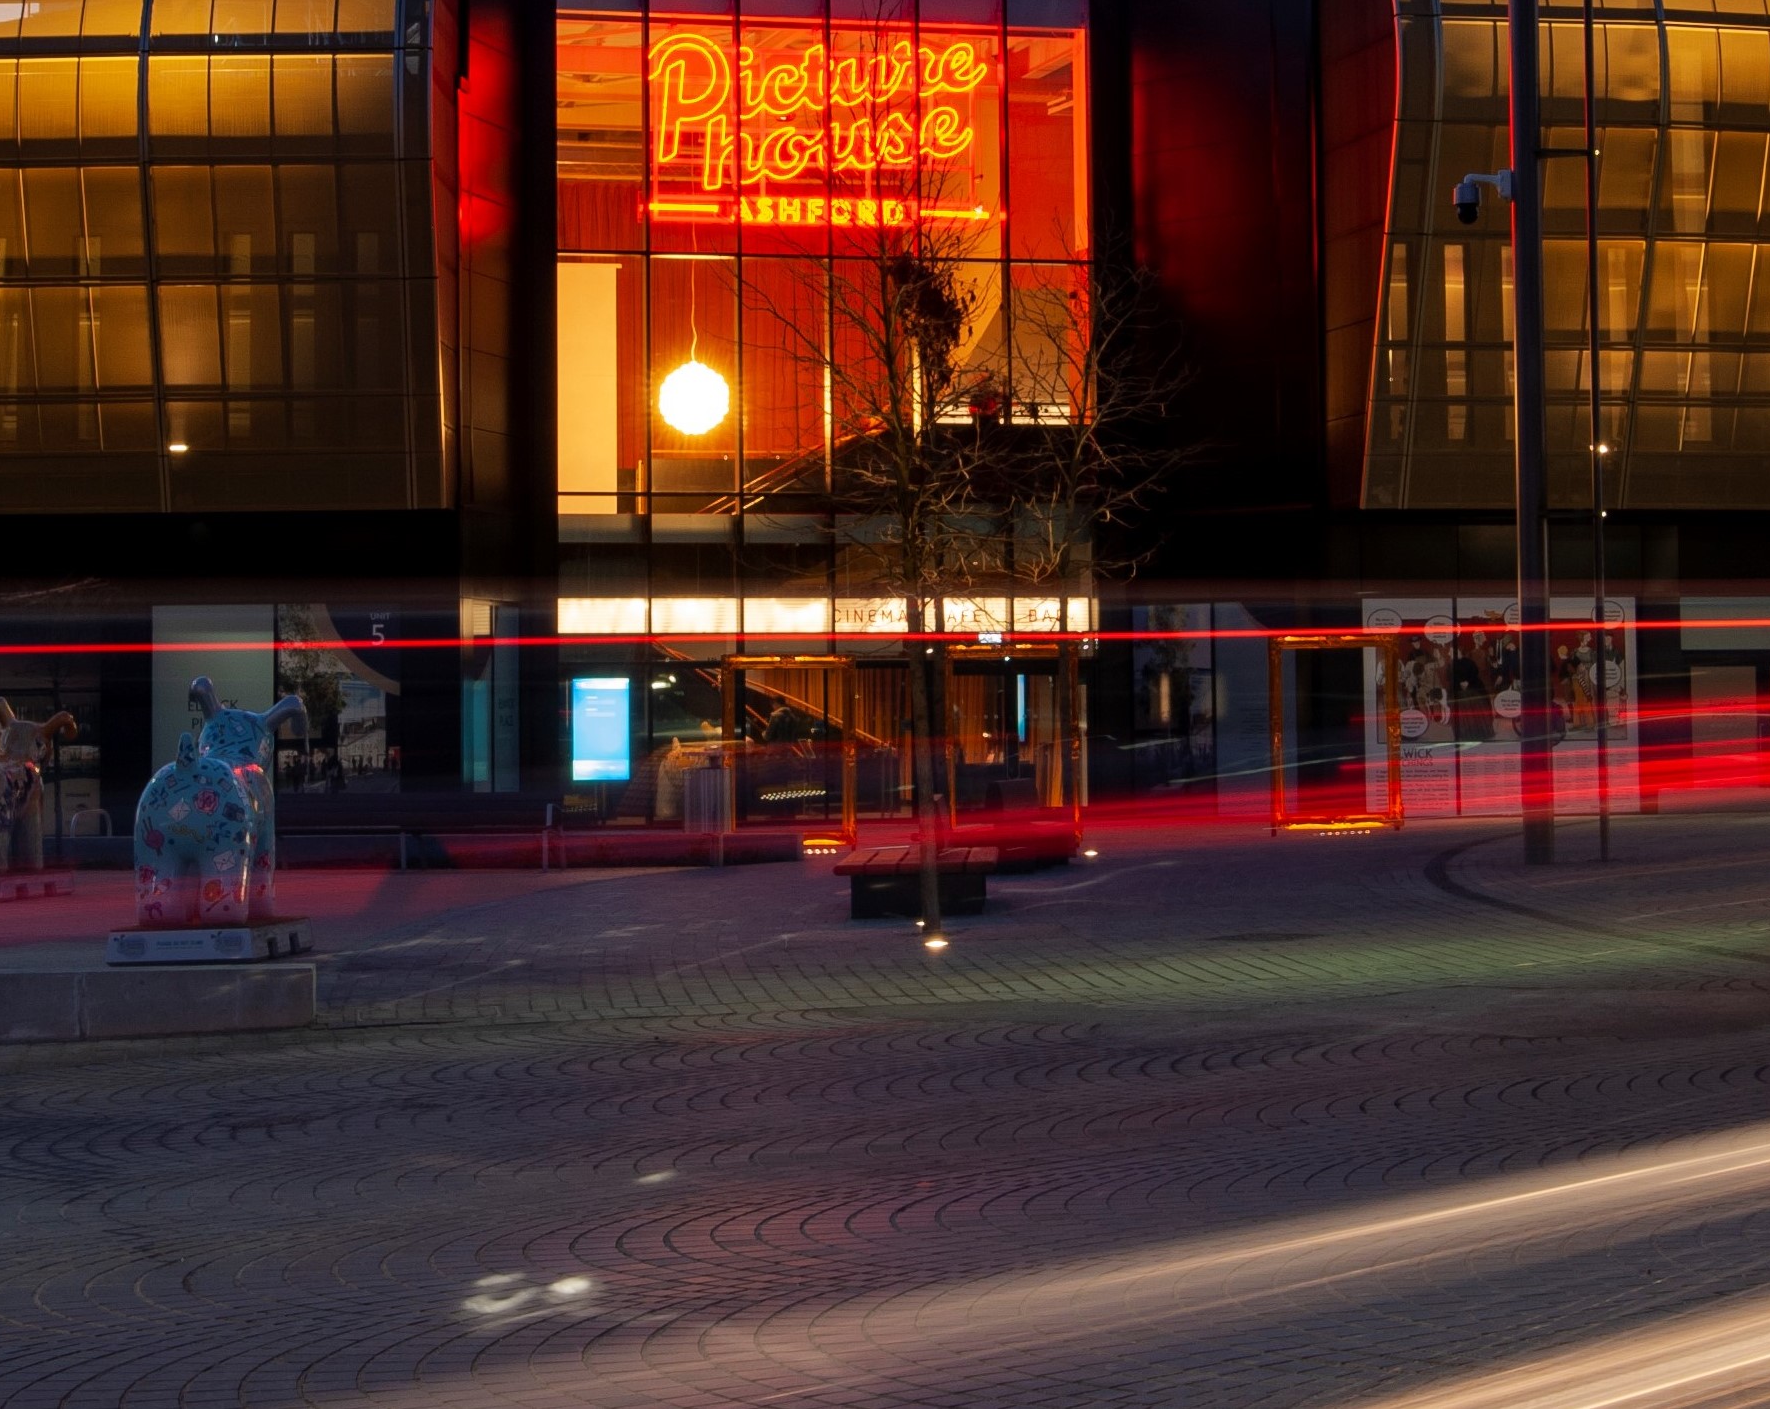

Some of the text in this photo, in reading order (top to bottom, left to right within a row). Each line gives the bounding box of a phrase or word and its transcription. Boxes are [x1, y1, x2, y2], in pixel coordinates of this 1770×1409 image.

[648, 33, 987, 163] Picture
[703, 106, 974, 191] house
[731, 197, 905, 226] ASHFORD
[370, 612, 390, 621] UNIT
[834, 608, 908, 623] CINEMA
[935, 608, 982, 623] AFE
[372, 623, 385, 646] 5
[188, 699, 238, 712] ELCK
[1402, 748, 1434, 759] WICK
